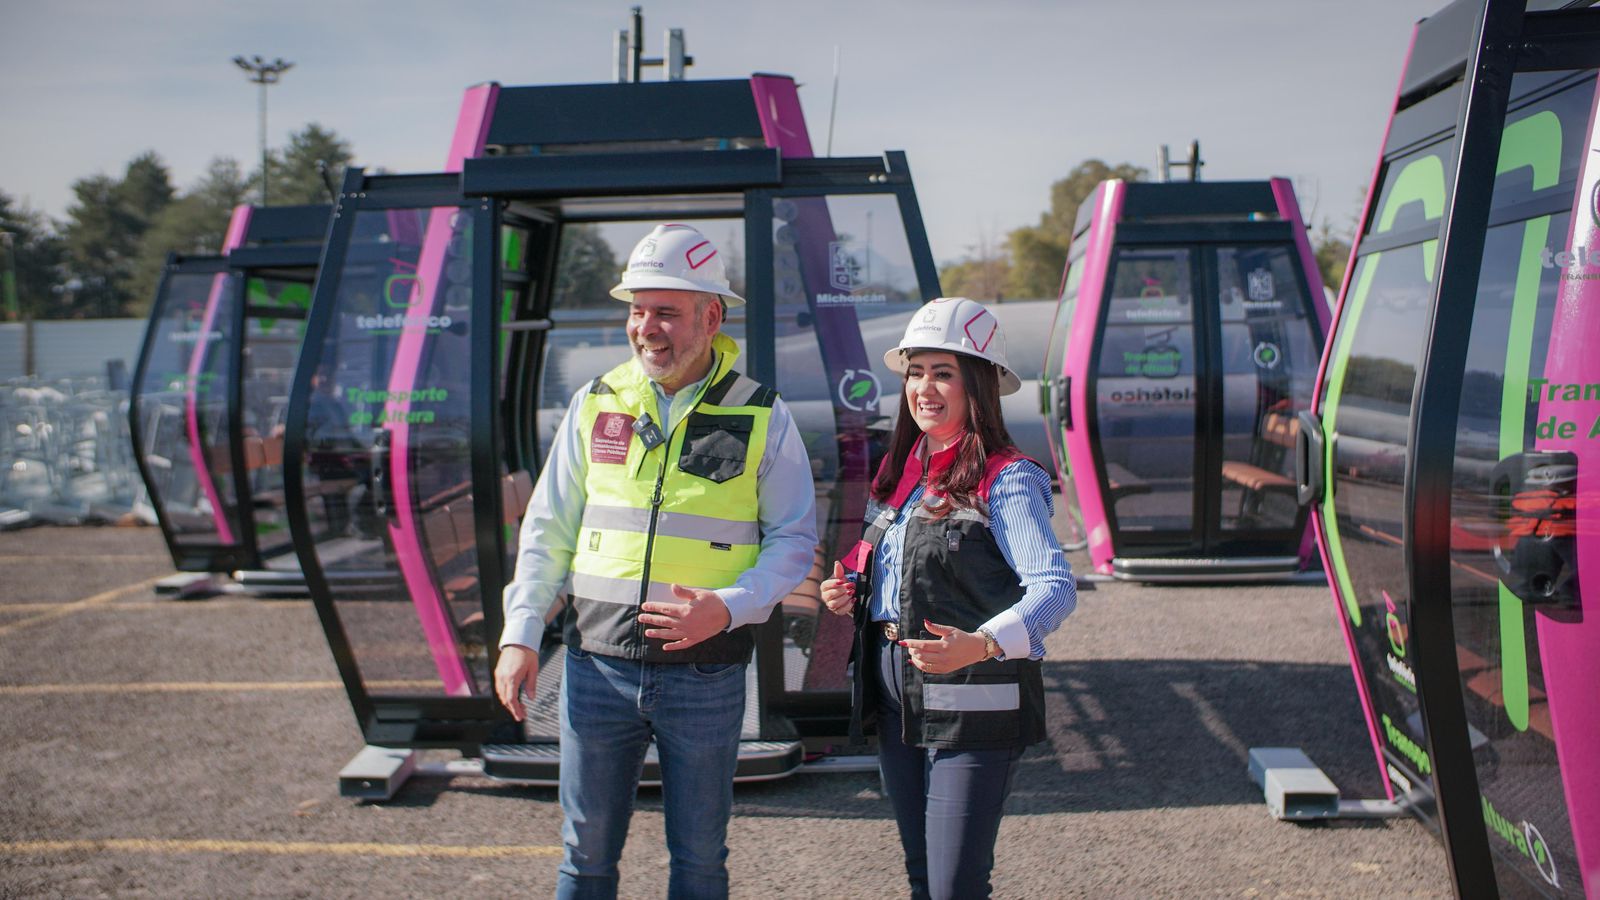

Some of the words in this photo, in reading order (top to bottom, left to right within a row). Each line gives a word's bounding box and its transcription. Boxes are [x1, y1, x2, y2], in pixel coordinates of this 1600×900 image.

[347, 387, 448, 403] Transporte
[350, 410, 373, 425] de
[377, 409, 435, 424] Altura
[1536, 416, 1577, 439] de
